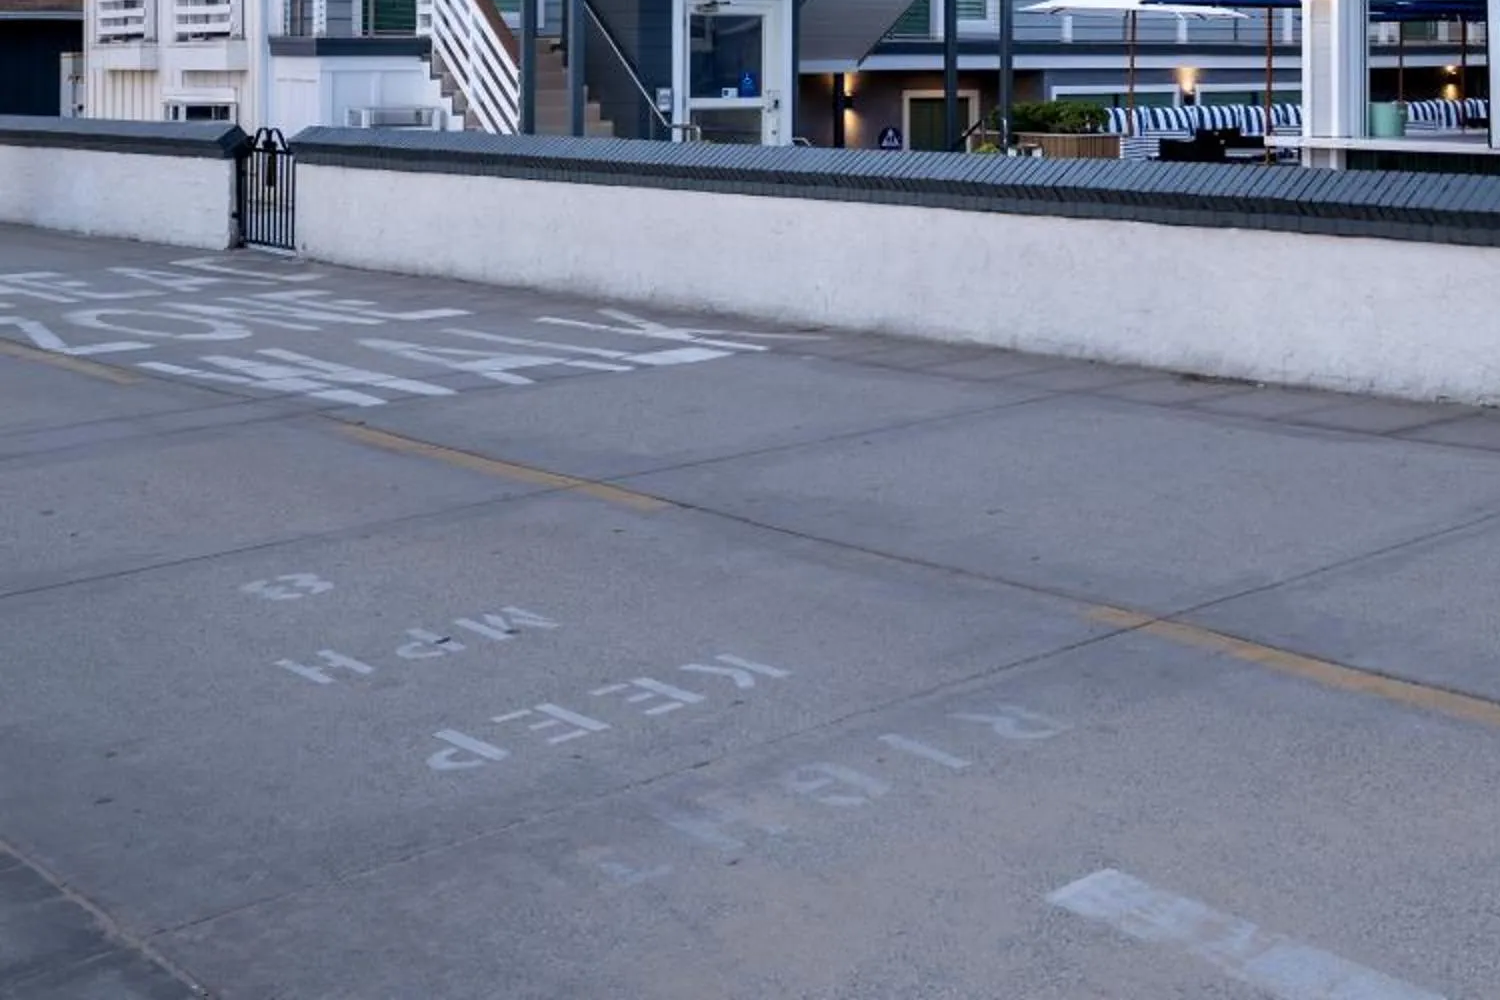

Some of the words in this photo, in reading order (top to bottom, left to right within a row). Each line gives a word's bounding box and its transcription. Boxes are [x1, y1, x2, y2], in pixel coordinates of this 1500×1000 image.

[0, 290, 472, 355] ZONE
[136, 309, 831, 406] WALK
[273, 606, 561, 684] MPH
[425, 653, 792, 771] KEEP
